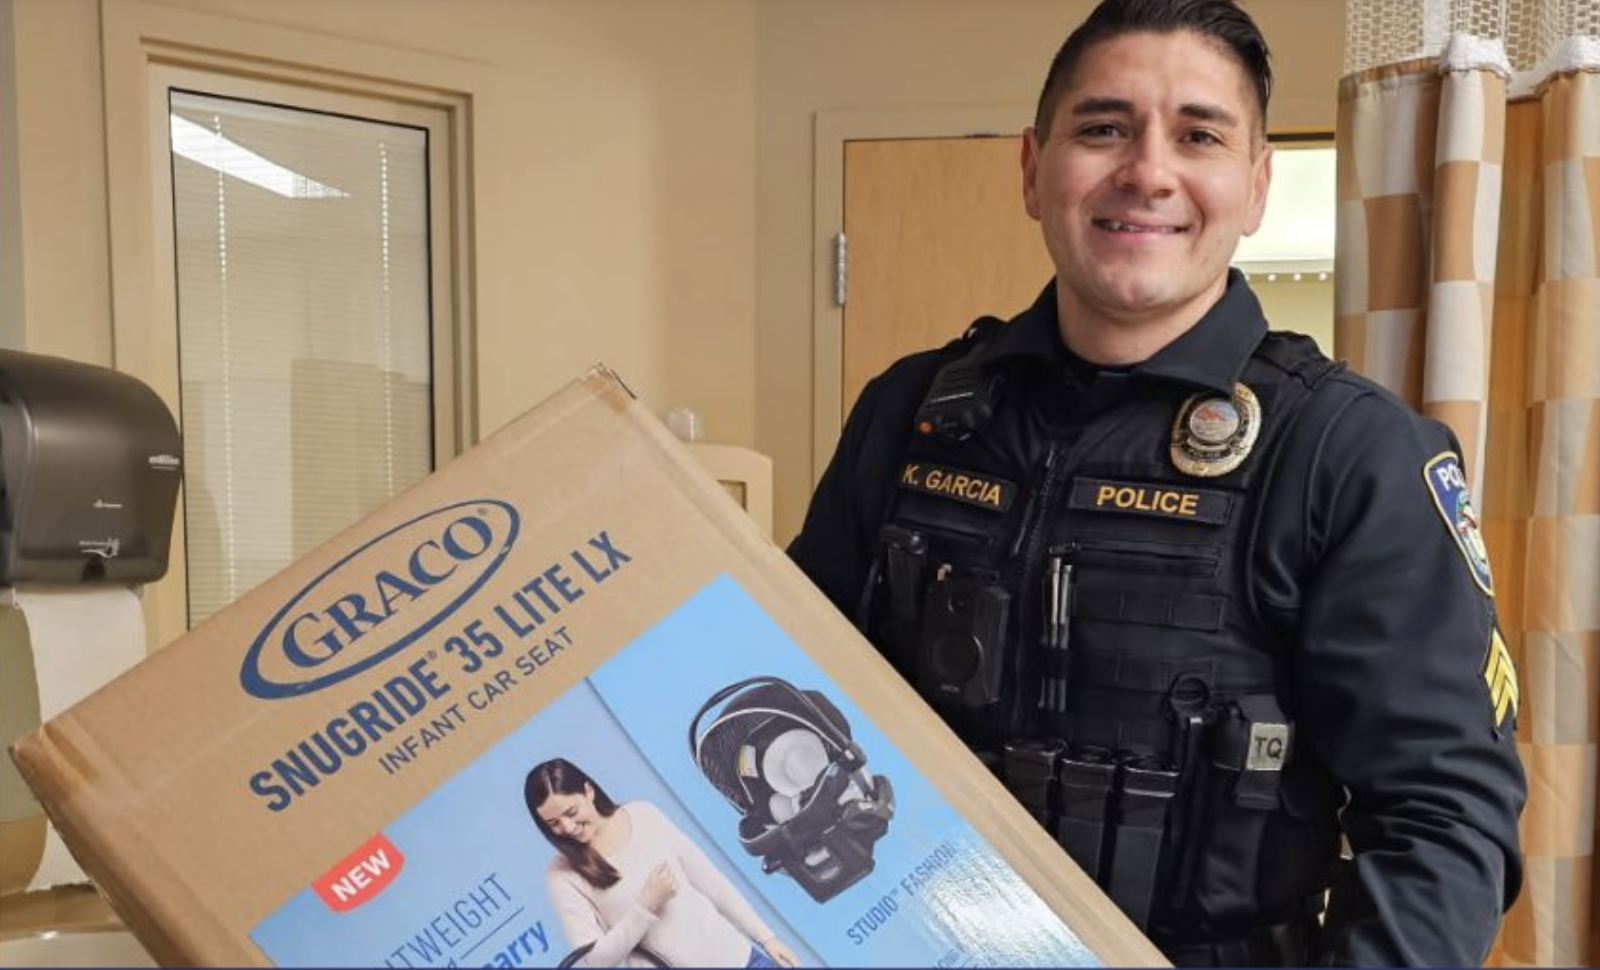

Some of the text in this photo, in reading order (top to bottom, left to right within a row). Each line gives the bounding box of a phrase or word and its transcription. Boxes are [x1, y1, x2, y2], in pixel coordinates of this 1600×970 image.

[902, 464, 1001, 505] K. GARCIA
[1096, 485, 1199, 515] POLICE
[444, 619, 504, 675] 35
[493, 564, 585, 638] LITE
[571, 531, 632, 584] LX
[378, 625, 574, 775] INFANT CAR SEAT
[1254, 736, 1282, 760] TQ
[331, 848, 391, 902] NEW
[900, 842, 957, 896] FASHION
[482, 919, 549, 968] arry
